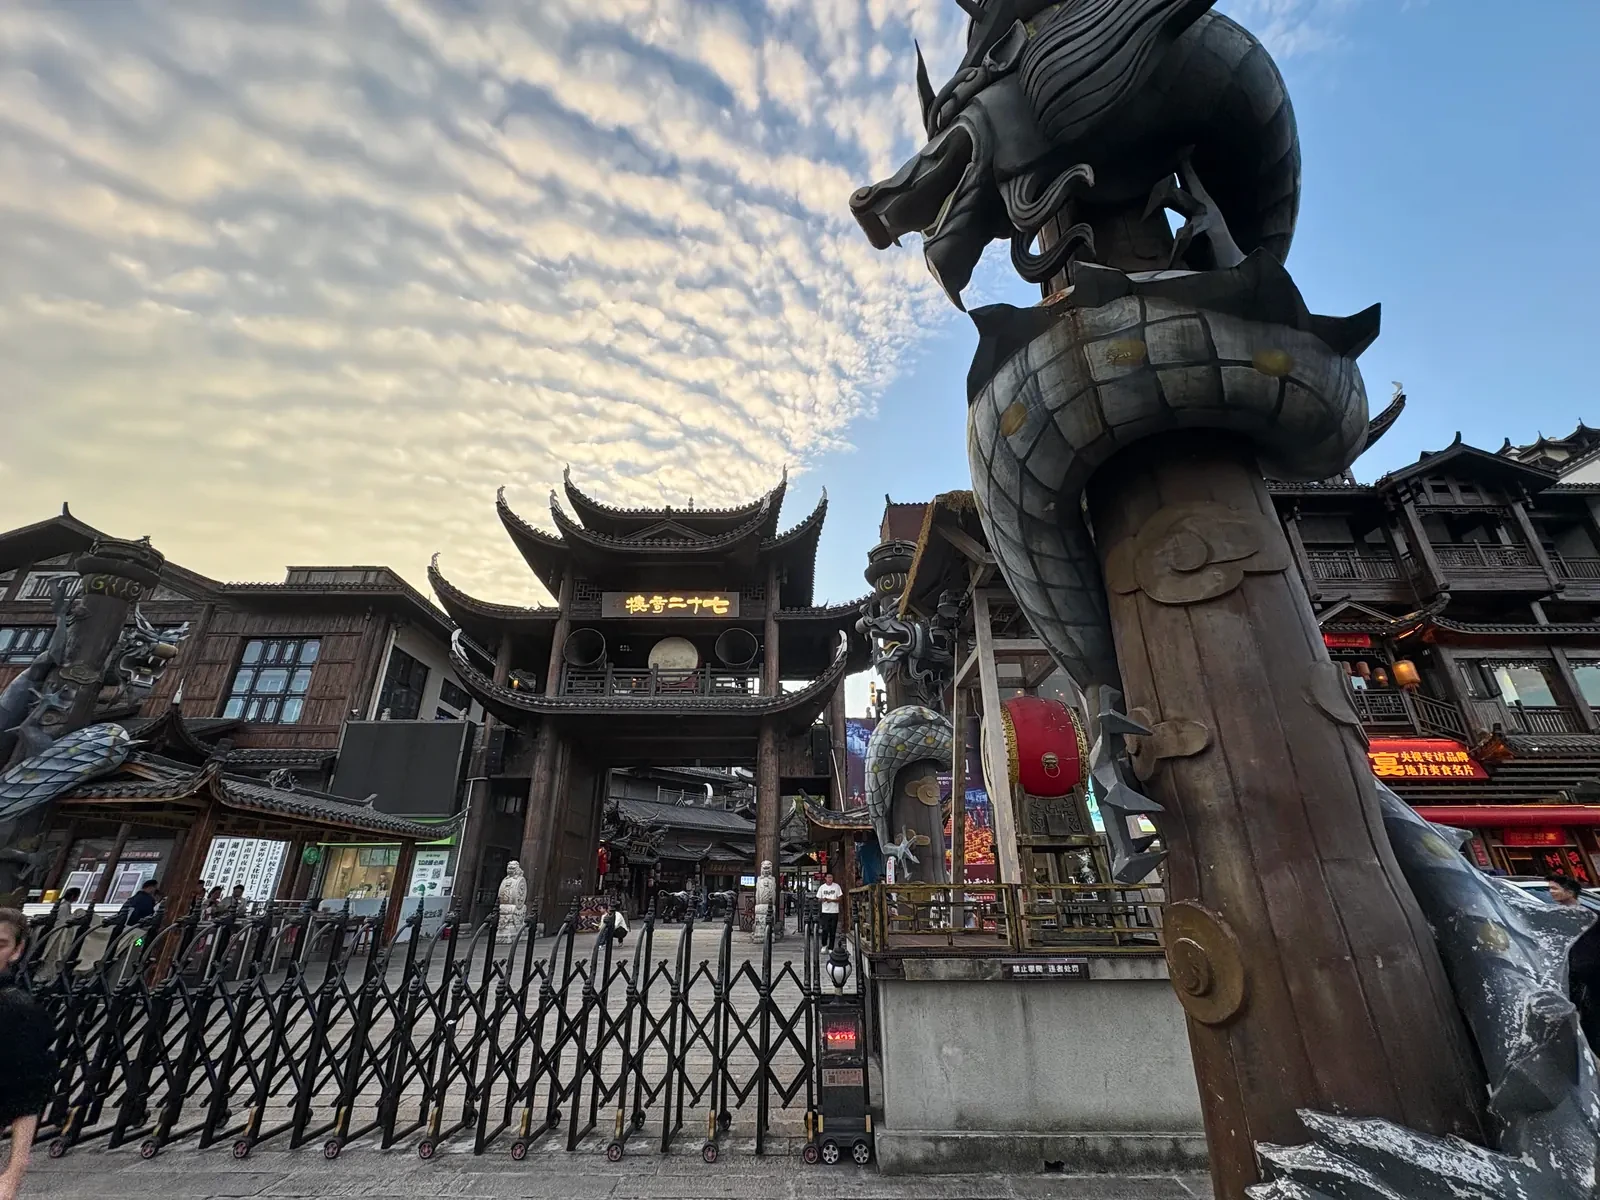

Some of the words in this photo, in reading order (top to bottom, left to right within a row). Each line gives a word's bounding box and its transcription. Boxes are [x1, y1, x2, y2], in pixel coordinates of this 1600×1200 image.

[1401, 750, 1470, 763] 央视专访品牌
[1367, 752, 1406, 776] 宴
[1404, 763, 1474, 776] 地方美食名片
